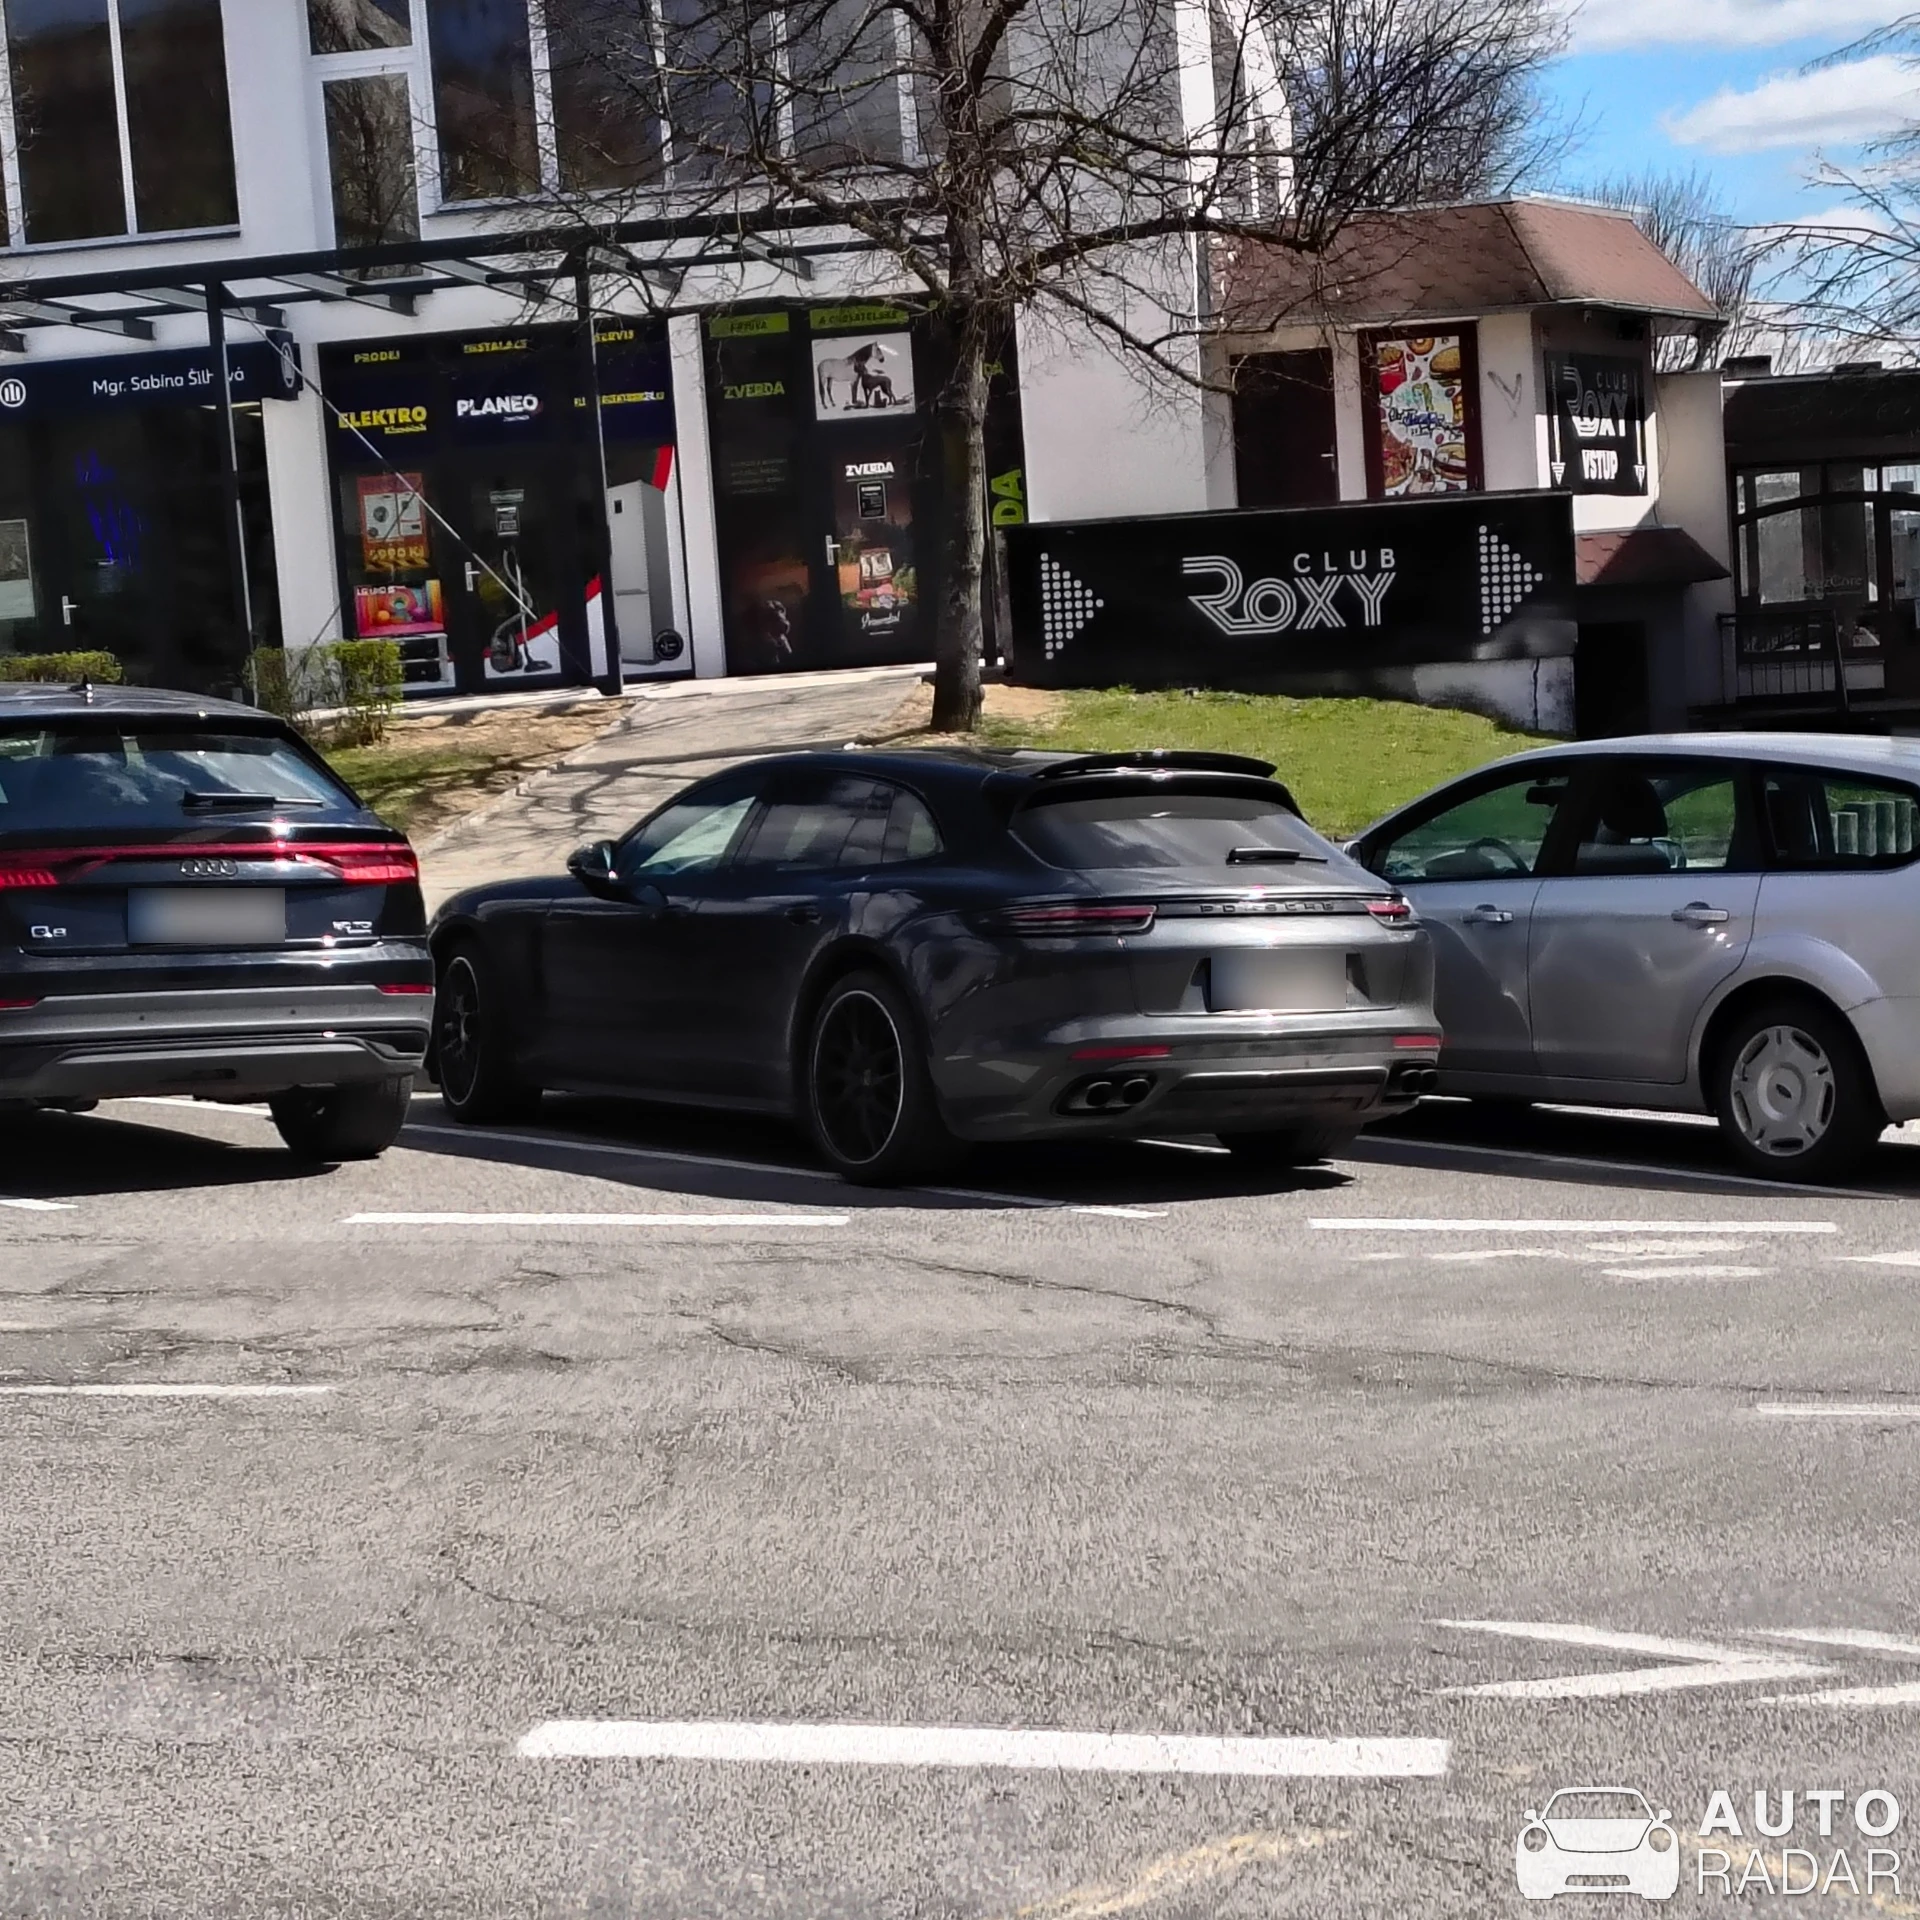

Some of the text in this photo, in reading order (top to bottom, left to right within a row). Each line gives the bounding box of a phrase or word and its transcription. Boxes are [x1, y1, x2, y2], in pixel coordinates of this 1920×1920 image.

[92, 379, 127, 397] Mgr.
[131, 374, 184, 391] Sabina
[1595, 371, 1627, 391] CLUB
[338, 405, 428, 428] ELEKTRO
[456, 396, 538, 416] PLANEO
[1581, 448, 1619, 480] VSTUP
[1292, 547, 1397, 574] CLUB
[31, 925, 67, 938] Q8
